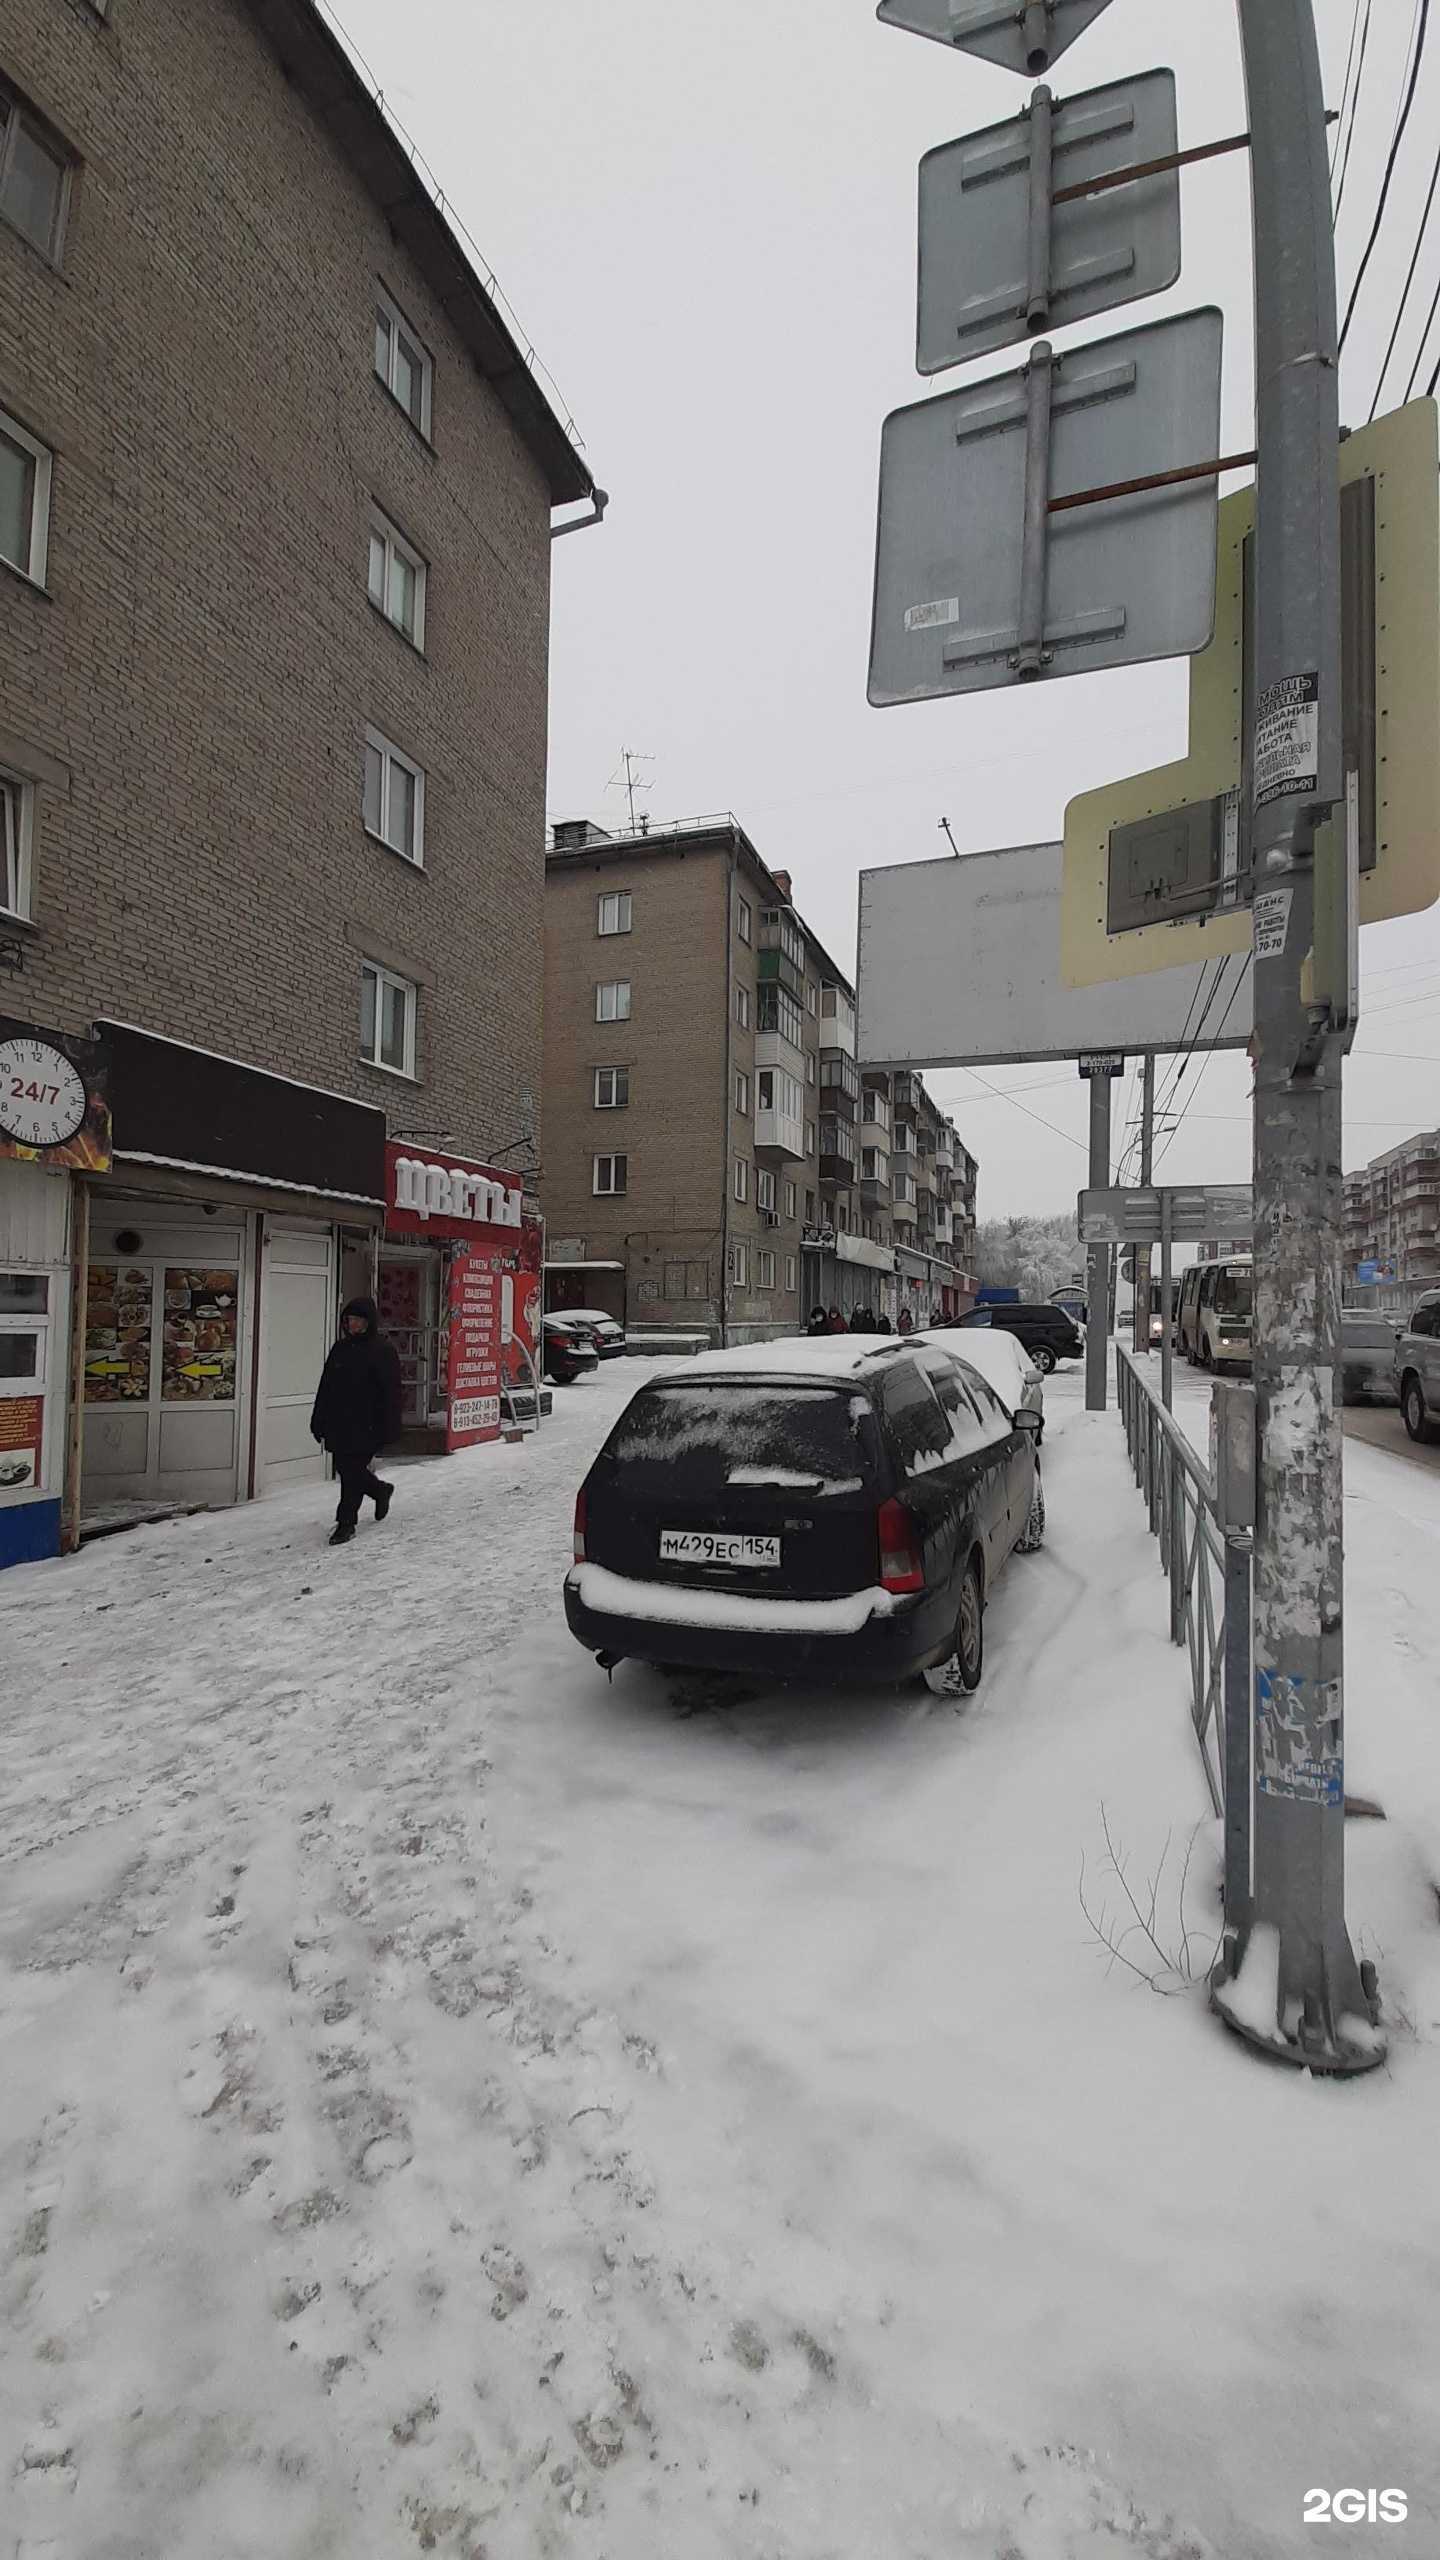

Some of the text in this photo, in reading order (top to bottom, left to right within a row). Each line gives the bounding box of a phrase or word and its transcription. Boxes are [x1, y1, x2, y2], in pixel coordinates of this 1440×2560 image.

[1257, 676, 1312, 706] МОЩЬ
[15, 1052, 24, 1063] 11
[32, 1052, 42, 1063] 12
[11, 1077, 60, 1105] 24/7
[64, 1077, 71, 1088] 2
[395, 1157, 522, 1228] ЦВЕТЫ
[745, 1538, 775, 1556] 154
